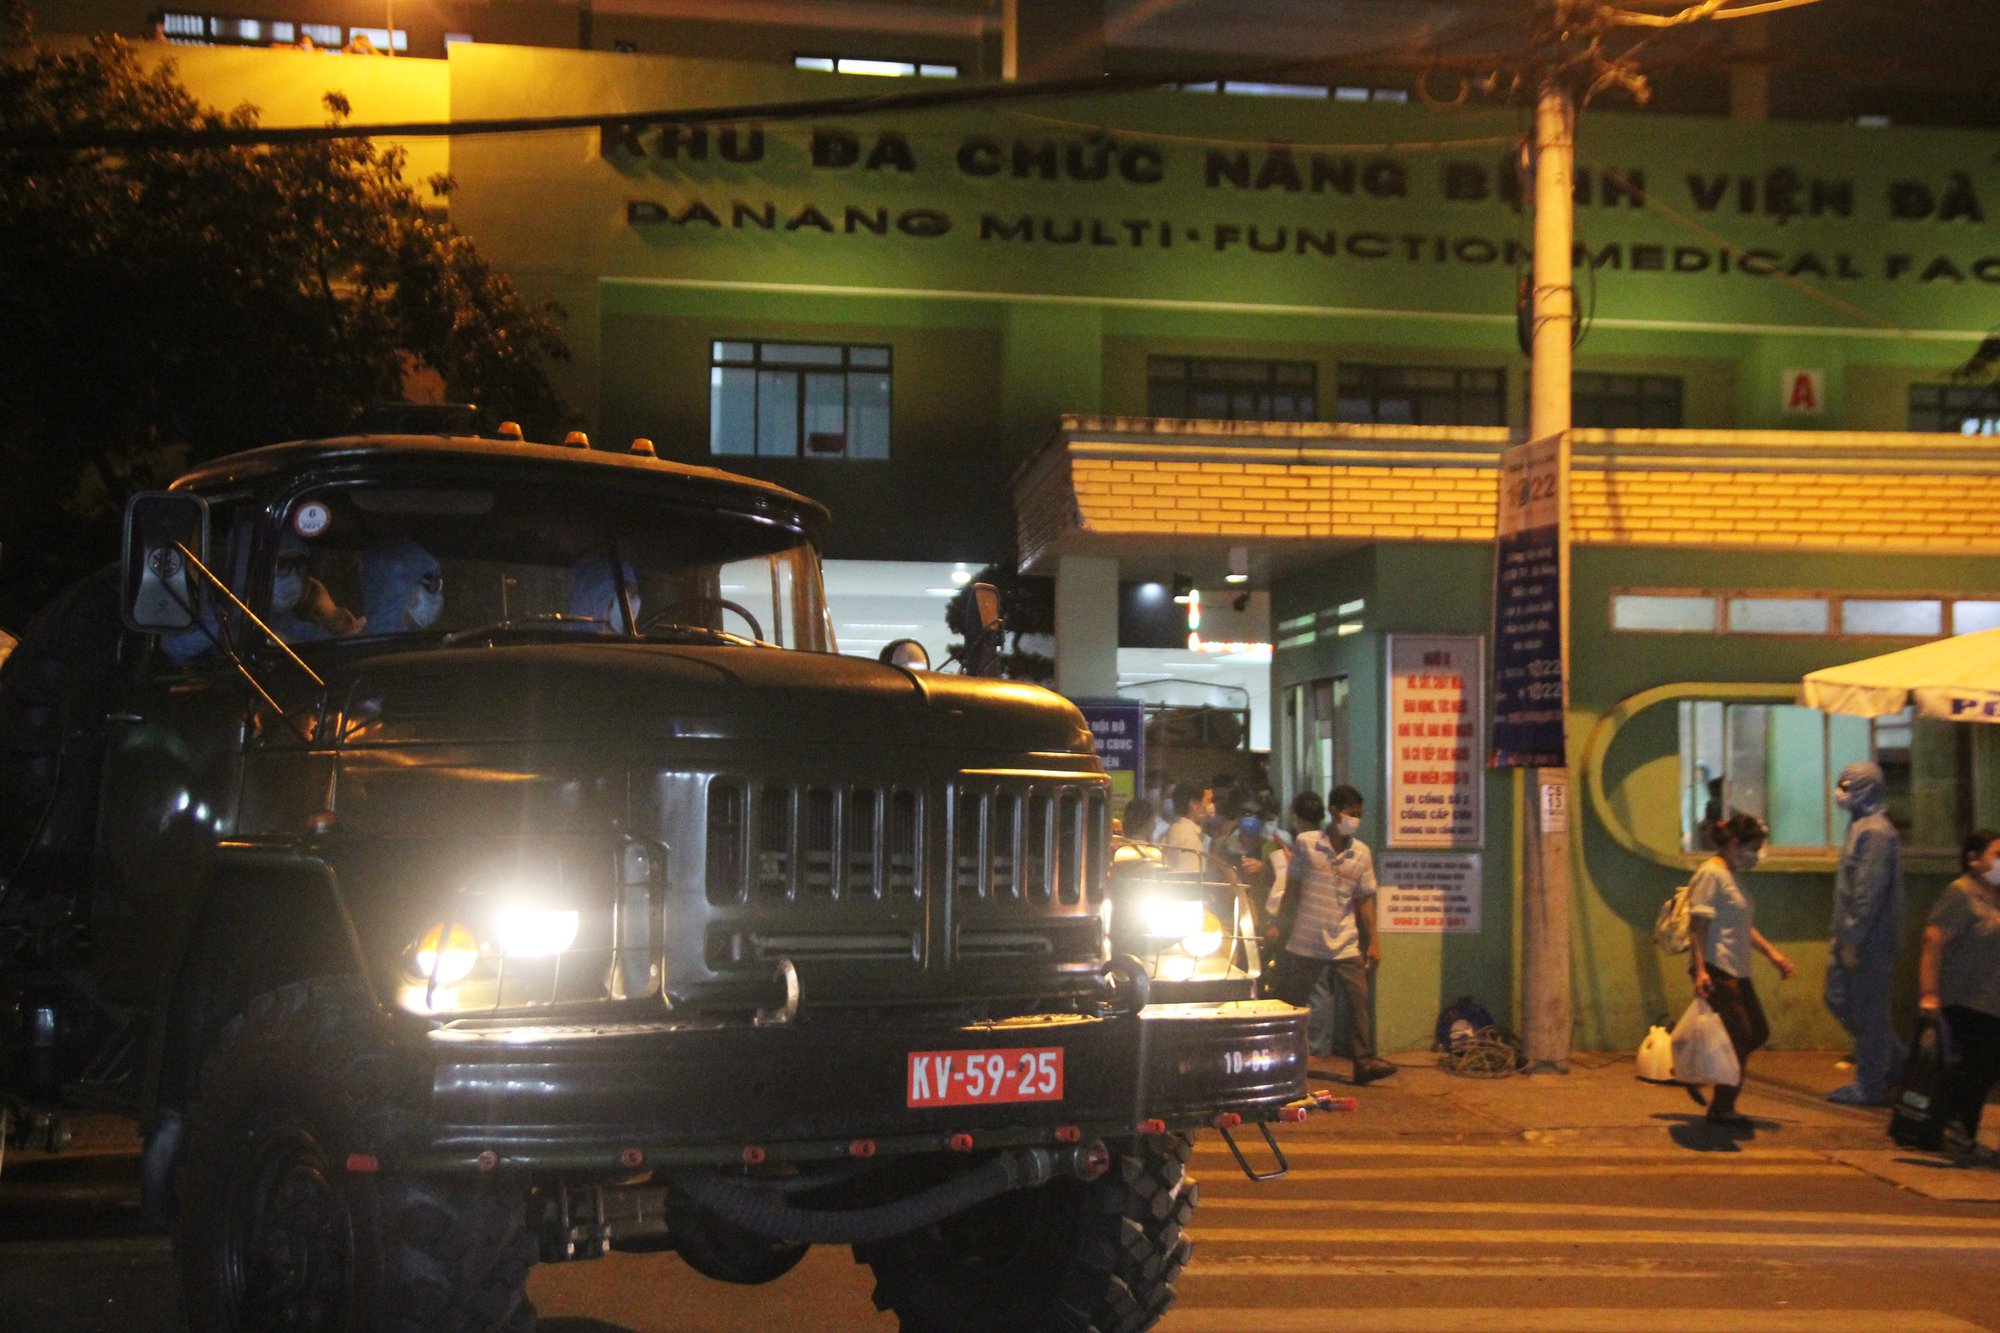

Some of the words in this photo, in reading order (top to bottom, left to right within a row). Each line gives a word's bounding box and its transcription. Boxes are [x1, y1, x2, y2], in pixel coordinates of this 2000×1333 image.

[627, 199, 952, 238] DANANG
[1572, 241, 1864, 281] MEDICAL
[1789, 372, 1817, 409] A
[308, 508, 317, 518] 6
[912, 1052, 1057, 1100] KV-59-25
